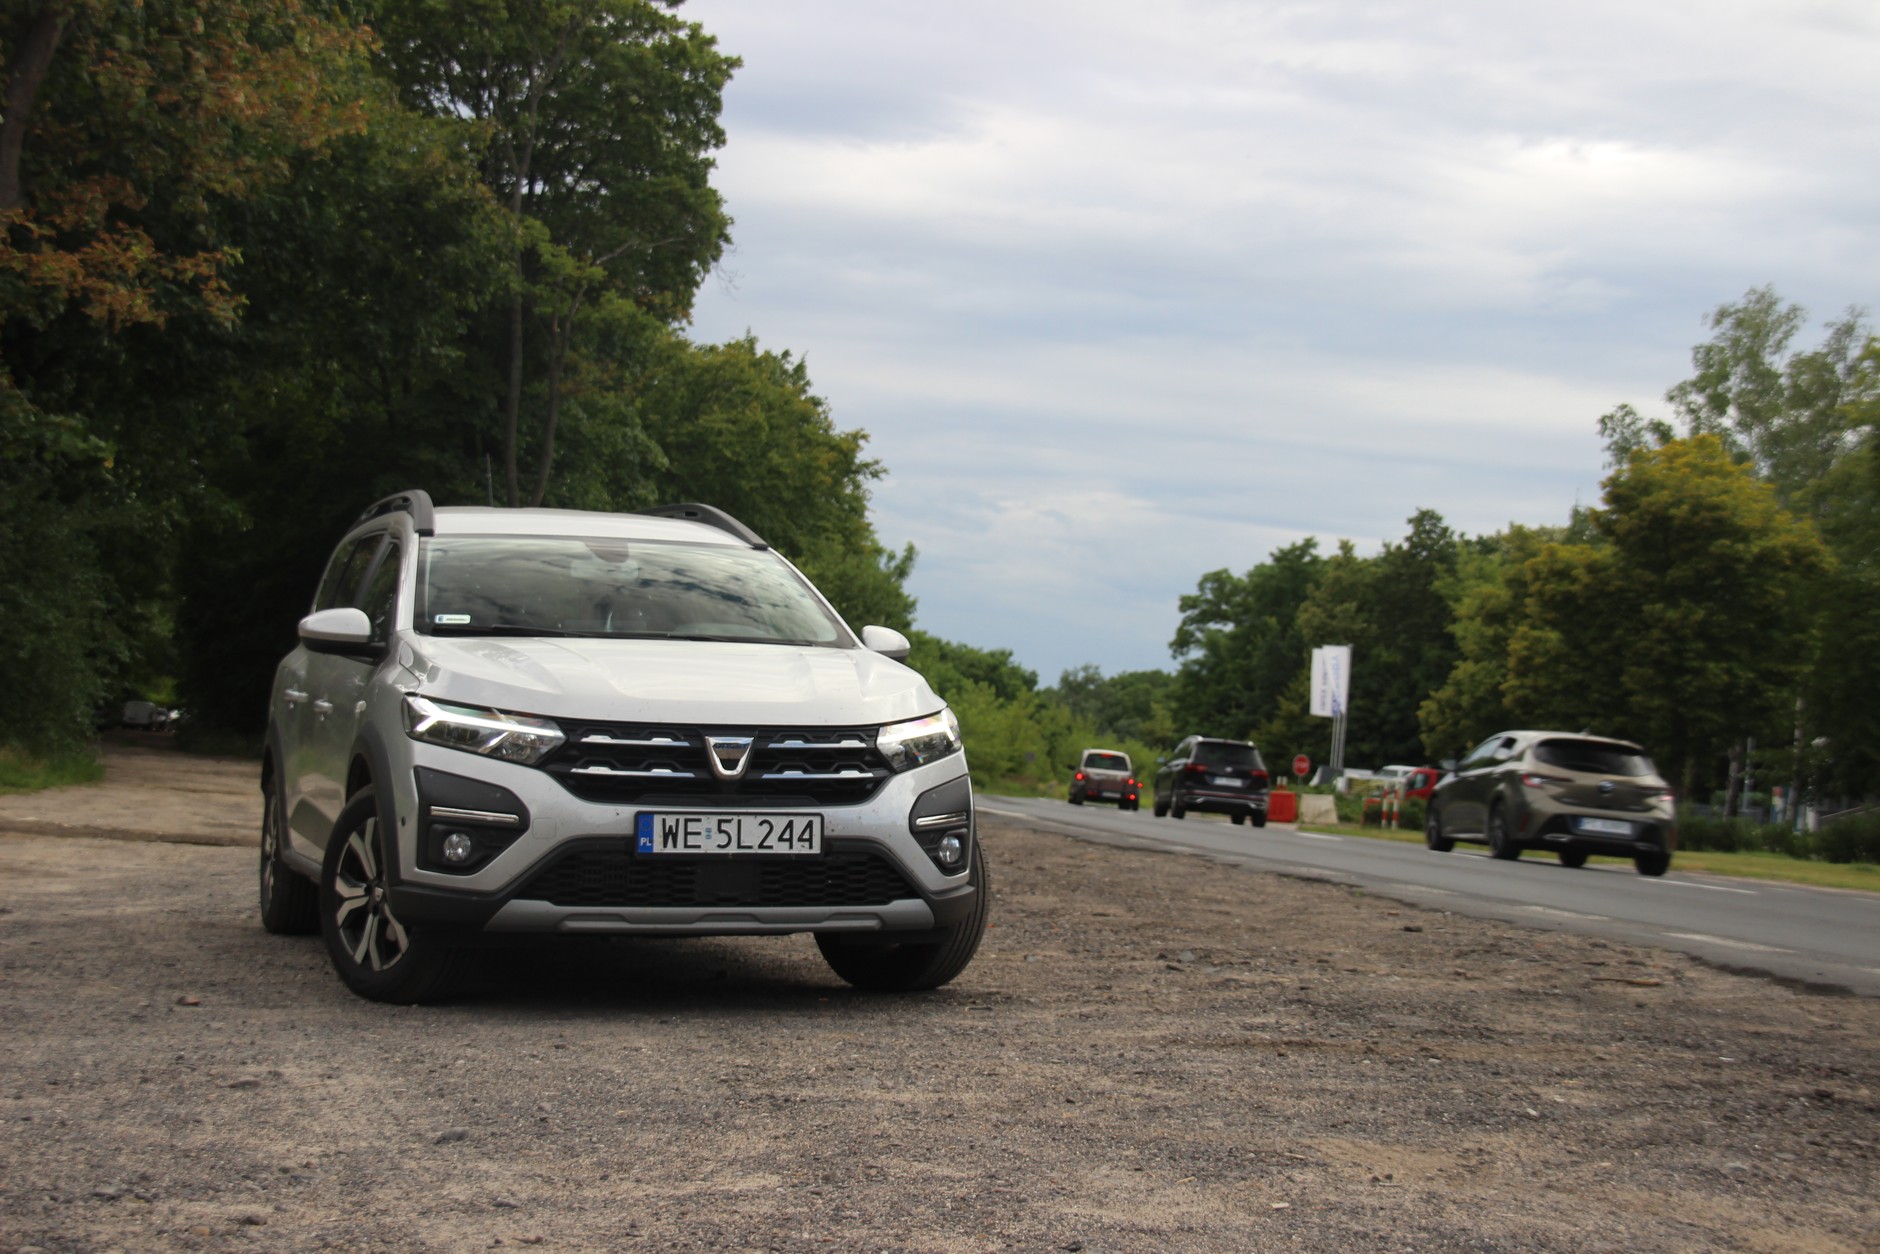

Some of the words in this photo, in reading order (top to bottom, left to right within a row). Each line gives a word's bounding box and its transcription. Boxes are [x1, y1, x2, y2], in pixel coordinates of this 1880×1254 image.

[640, 837, 652, 846] PL
[662, 818, 702, 849] WE
[716, 818, 814, 850] 5L244
